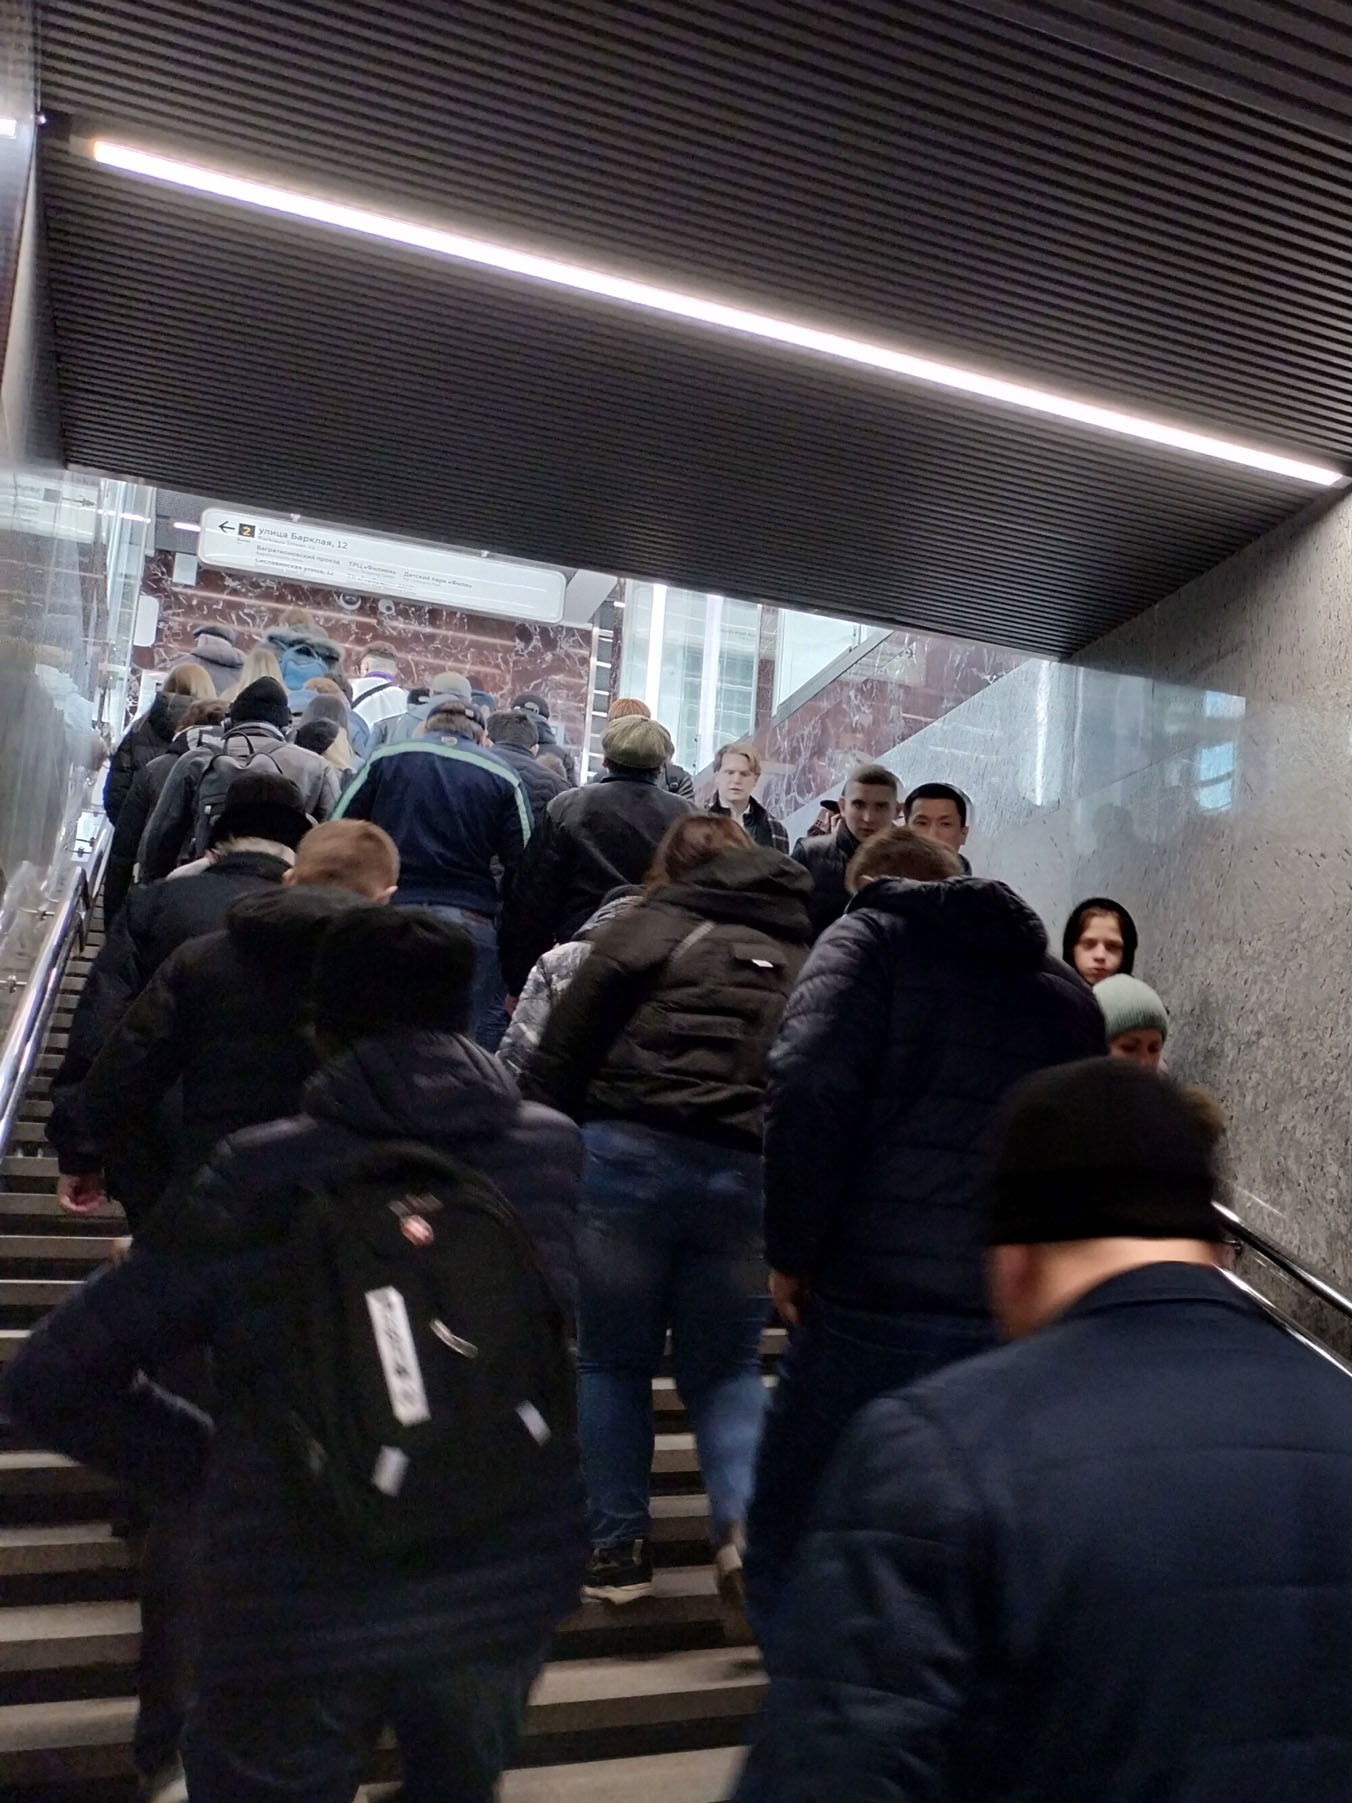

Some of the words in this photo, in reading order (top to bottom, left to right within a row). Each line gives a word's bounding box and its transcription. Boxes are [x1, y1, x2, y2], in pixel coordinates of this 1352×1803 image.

[242, 526, 251, 536] 2
[258, 528, 288, 539] улица
[291, 533, 335, 548] Барклая,
[337, 541, 348, 549] 12
